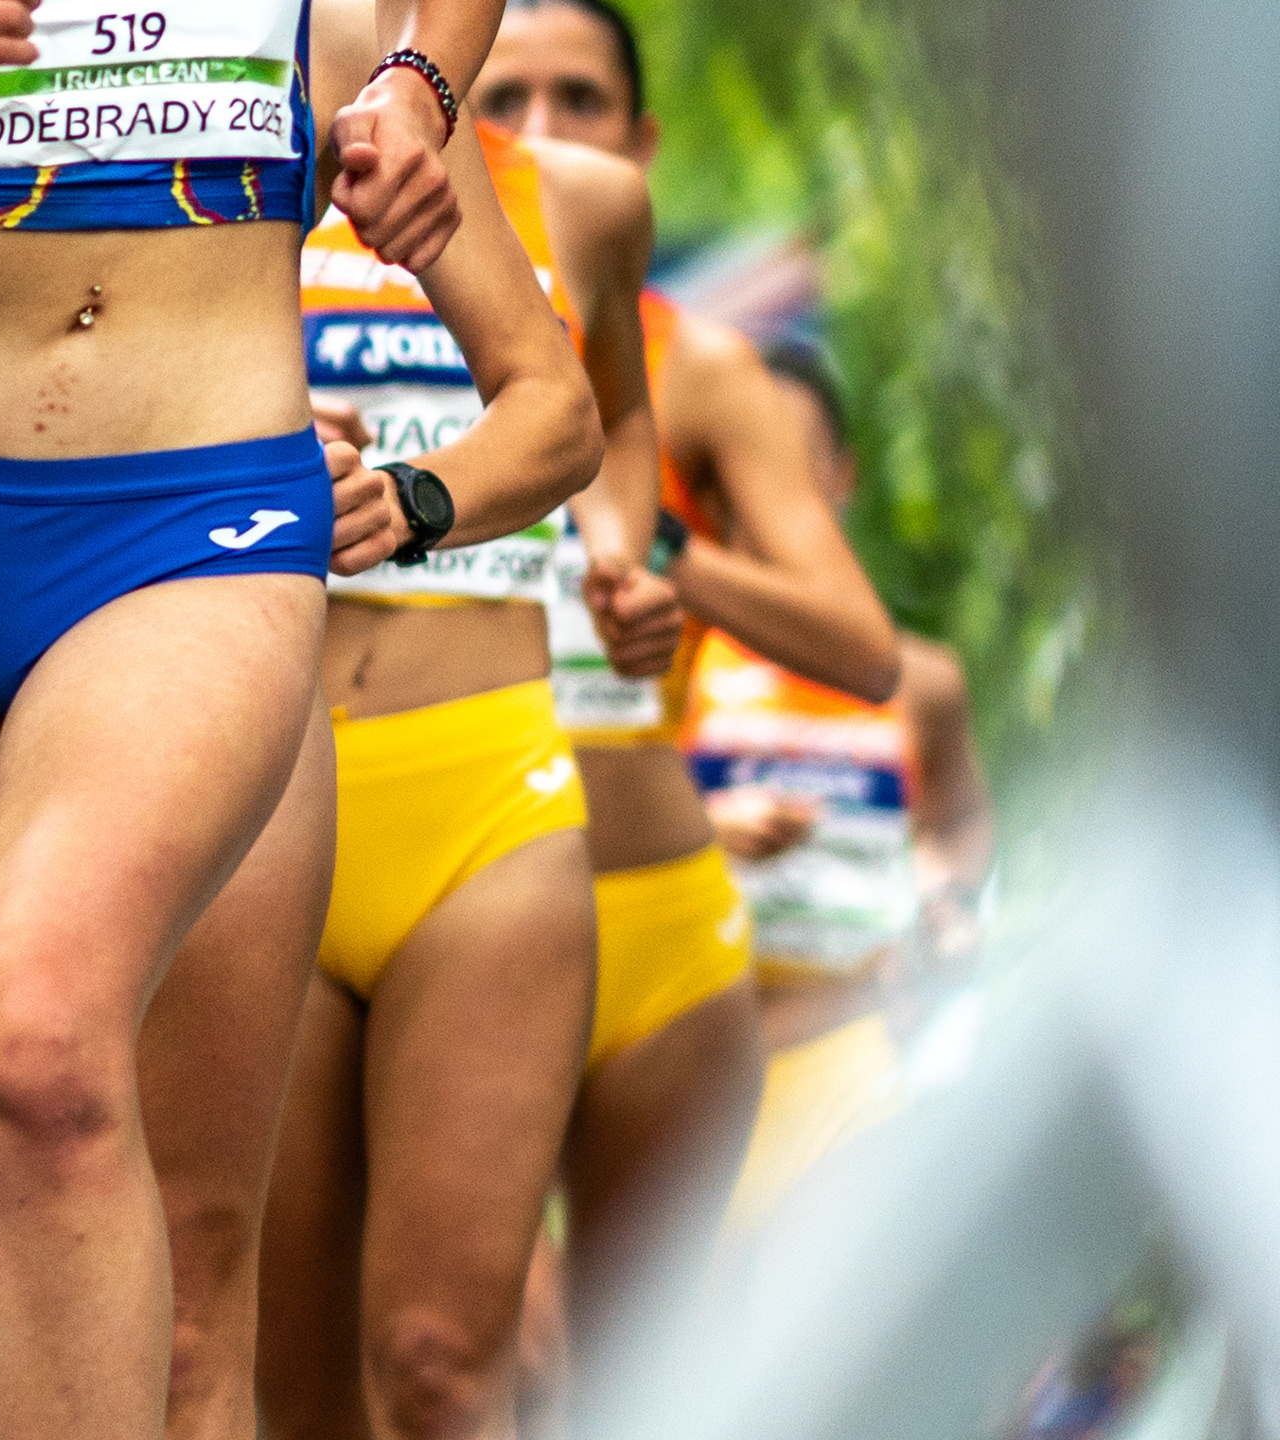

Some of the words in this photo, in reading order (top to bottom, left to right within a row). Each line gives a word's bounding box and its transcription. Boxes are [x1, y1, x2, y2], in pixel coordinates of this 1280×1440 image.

[90, 12, 167, 56] 519
[66, 67, 123, 91] RUN
[360, 323, 467, 373] Jom
